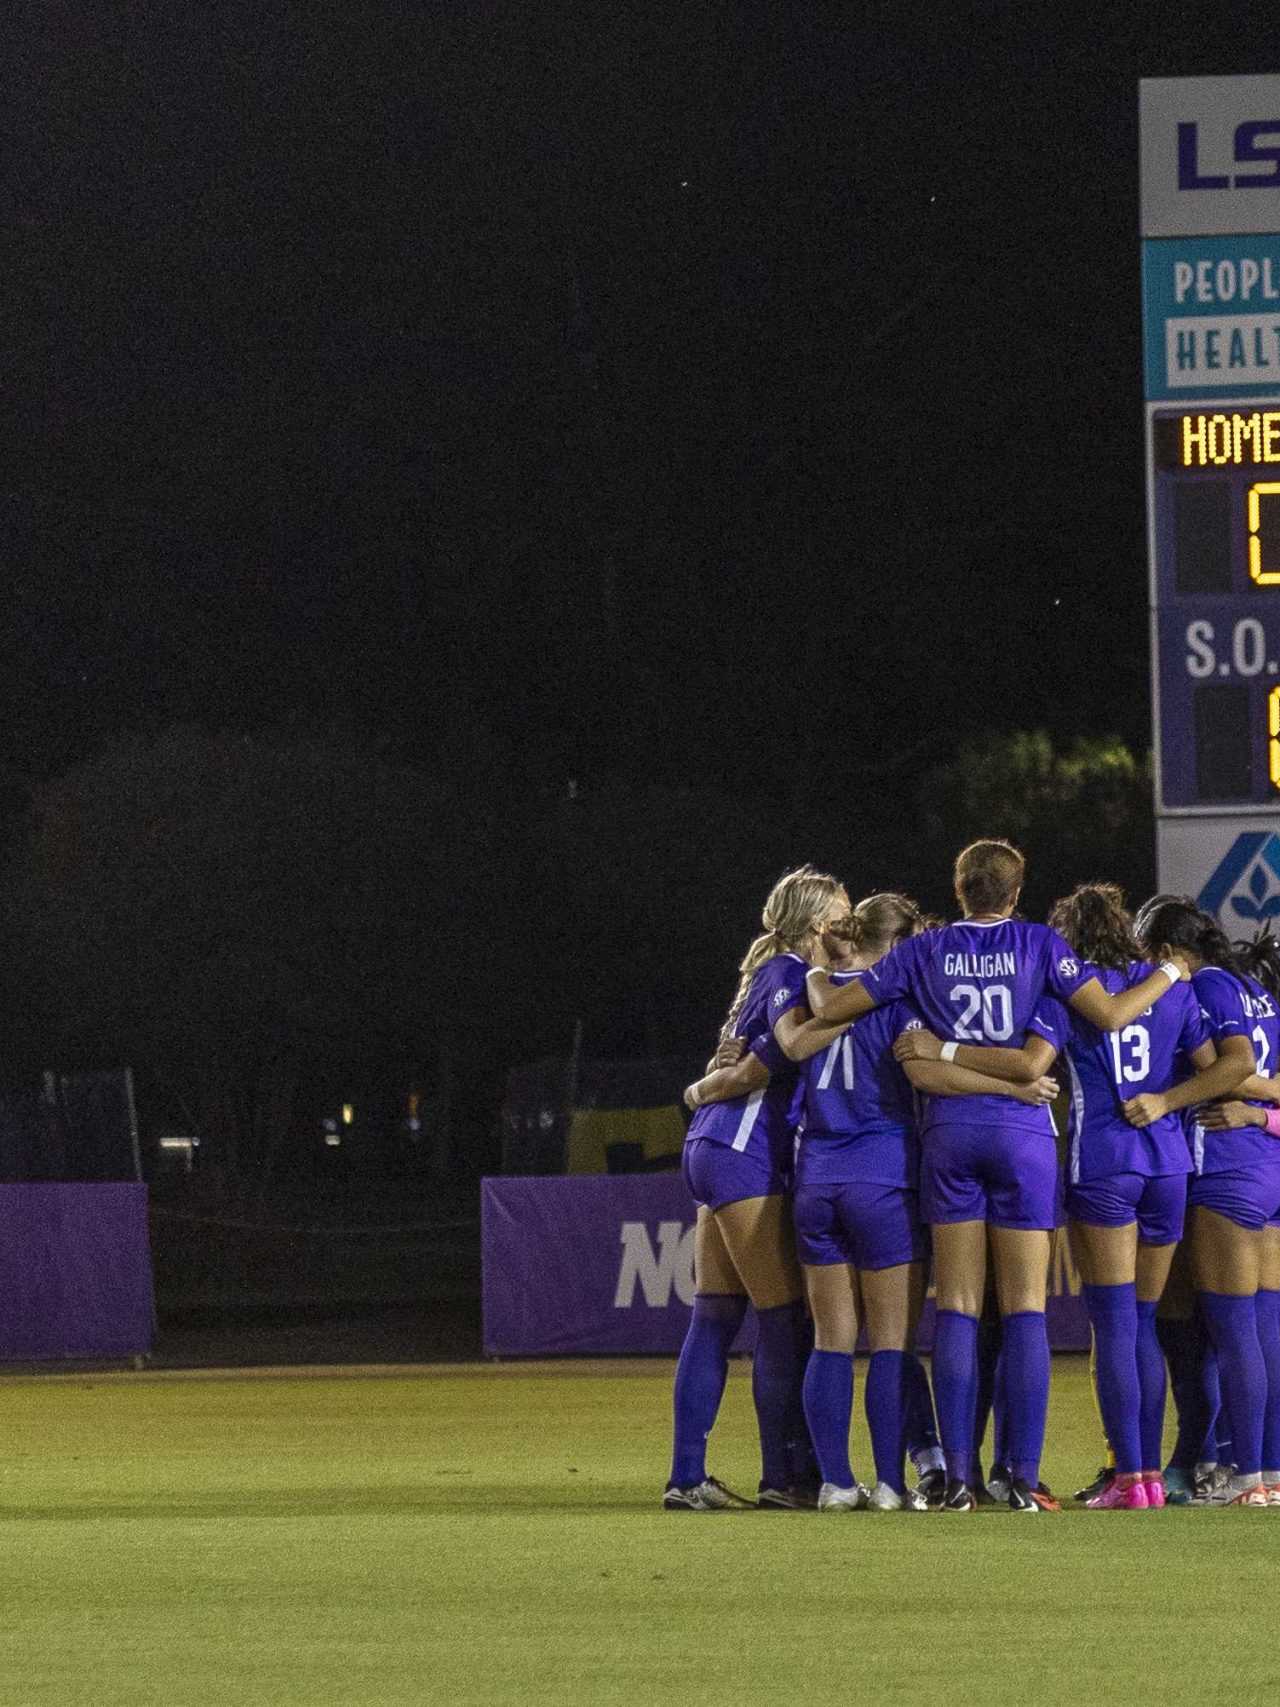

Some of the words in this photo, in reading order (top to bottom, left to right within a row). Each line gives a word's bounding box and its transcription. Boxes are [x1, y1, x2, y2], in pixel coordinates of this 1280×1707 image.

[944, 952, 1016, 978] GALLIGAN
[949, 984, 1013, 1041] 20
[1110, 1025, 1150, 1084] 13
